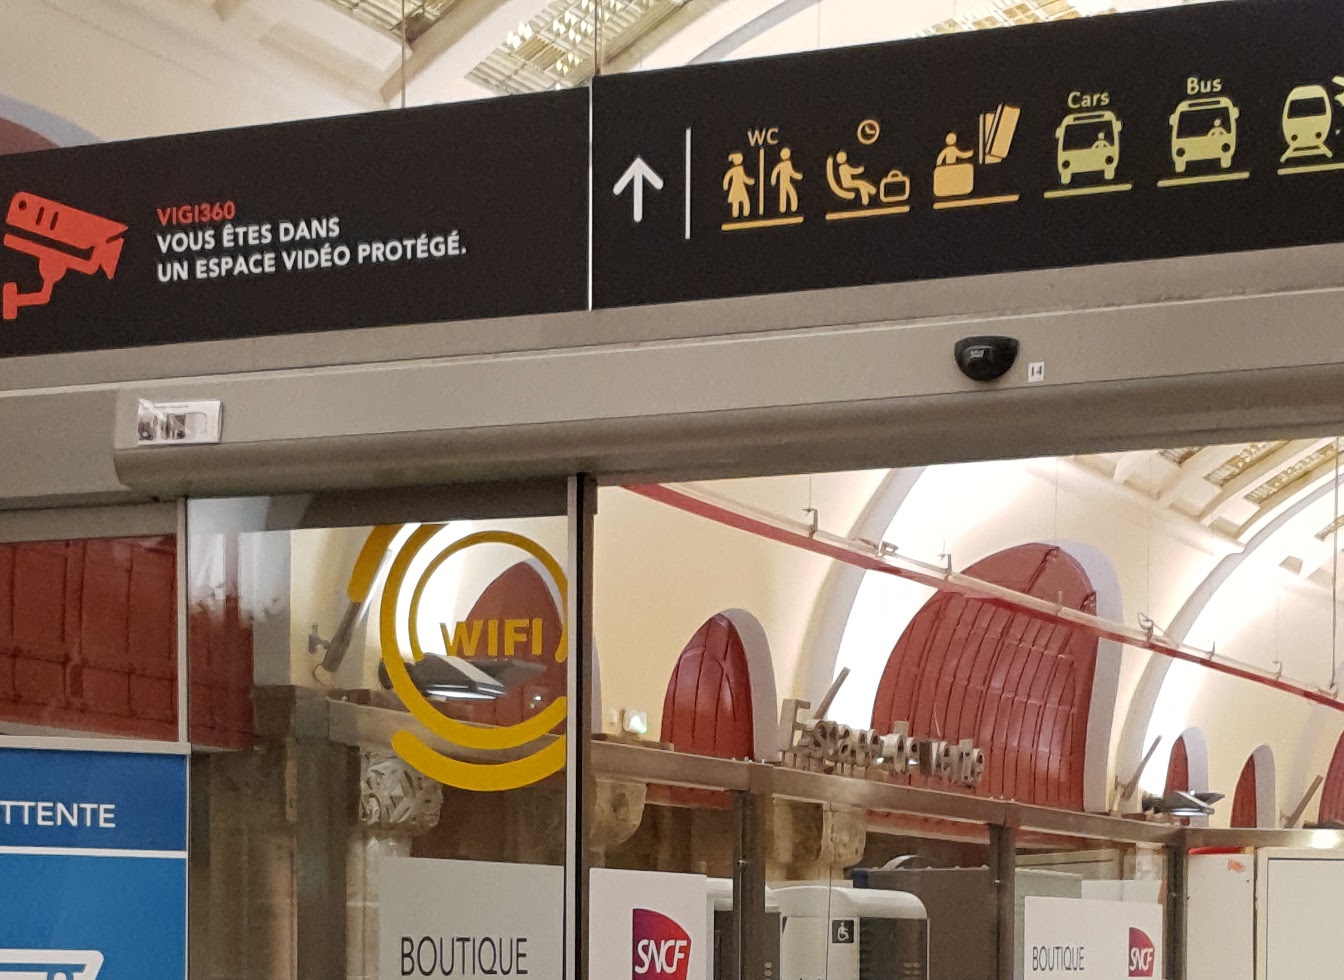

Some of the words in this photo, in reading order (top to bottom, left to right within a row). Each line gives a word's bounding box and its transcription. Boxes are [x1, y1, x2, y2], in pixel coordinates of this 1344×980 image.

[1187, 75, 1223, 96] Bus
[1067, 89, 1110, 109] Cars
[747, 128, 779, 147] WC
[158, 201, 236, 227] VIGI360
[158, 229, 216, 254] VOUS
[222, 220, 272, 250] ÊTES
[279, 216, 341, 245] DANS
[158, 258, 189, 283] UN
[195, 251, 276, 280] ESPACE
[281, 243, 351, 275] VIDÉO
[357, 230, 467, 267] PROTÉGÉ.
[440, 618, 543, 657] WIFI
[400, 936, 529, 976] BOUTIQUE
[635, 939, 687, 974] SNCF
[1032, 946, 1085, 971] BOUTIQUE
[1130, 947, 1154, 971] SNCF
